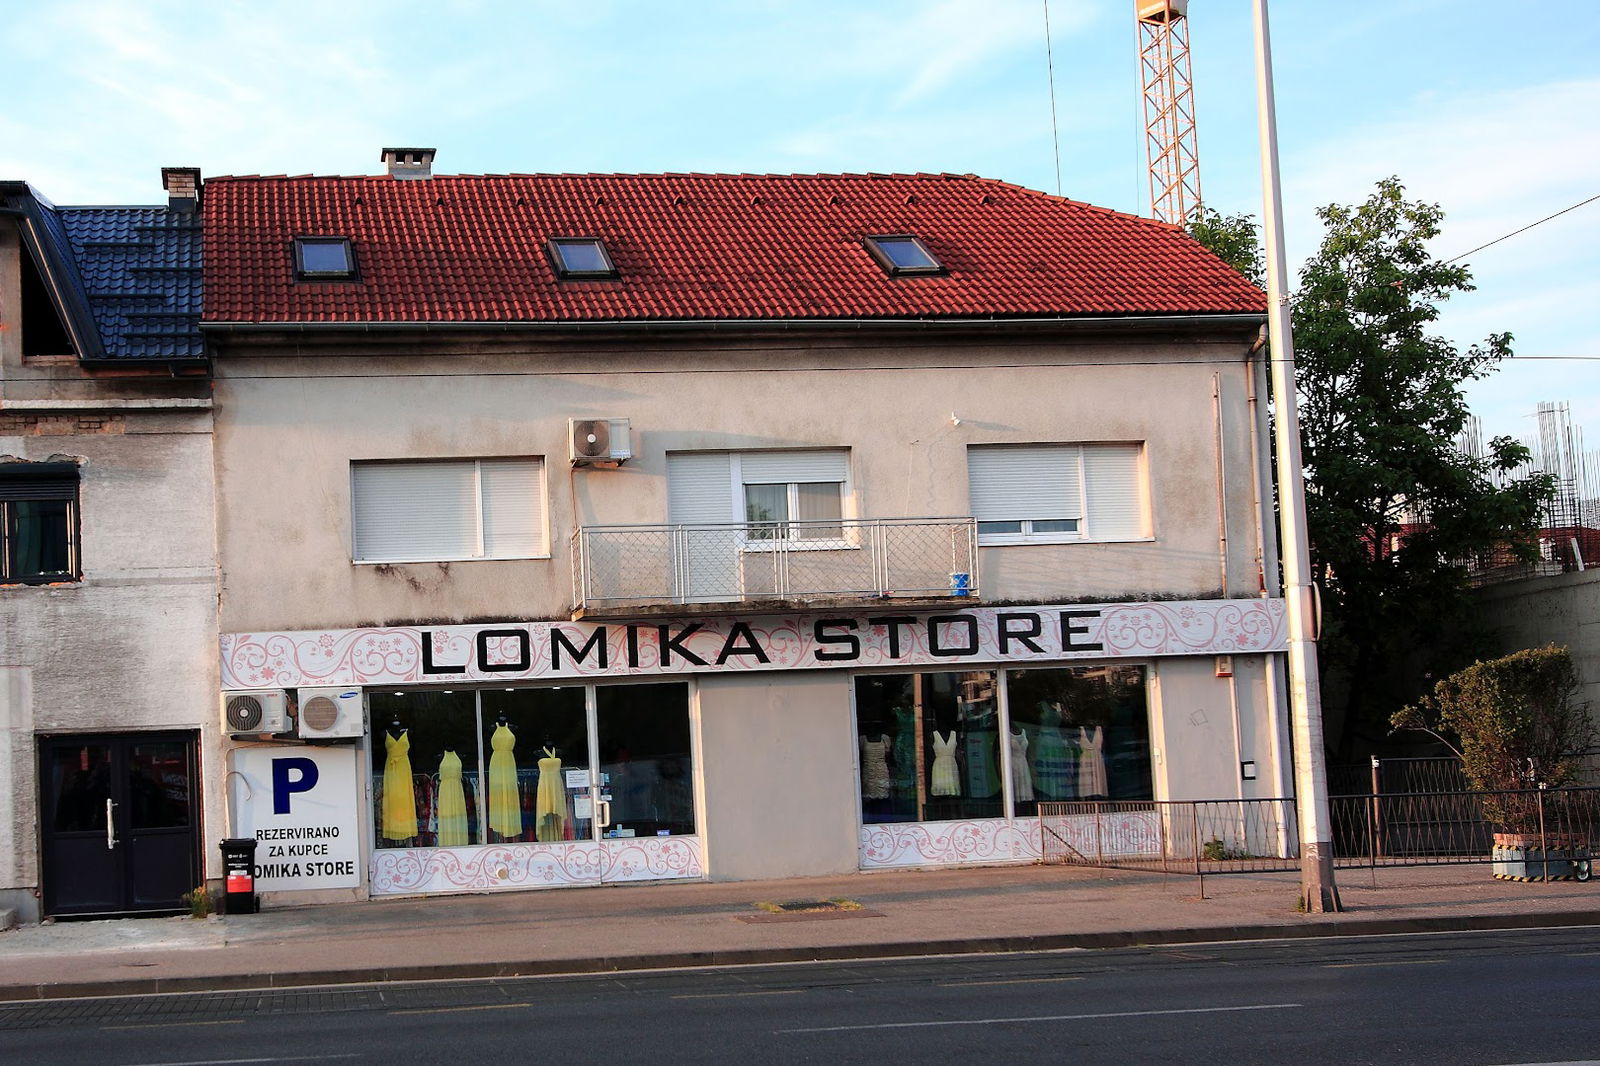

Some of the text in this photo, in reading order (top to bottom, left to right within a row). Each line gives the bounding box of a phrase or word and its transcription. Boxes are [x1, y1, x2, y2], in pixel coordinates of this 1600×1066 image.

[421, 611, 1103, 674] LOMIKA STORE
[272, 757, 319, 814] P
[256, 826, 340, 840] REZERVIRANO
[269, 844, 328, 857] ZA KUPCE
[254, 861, 354, 879] OMIKA STORE
